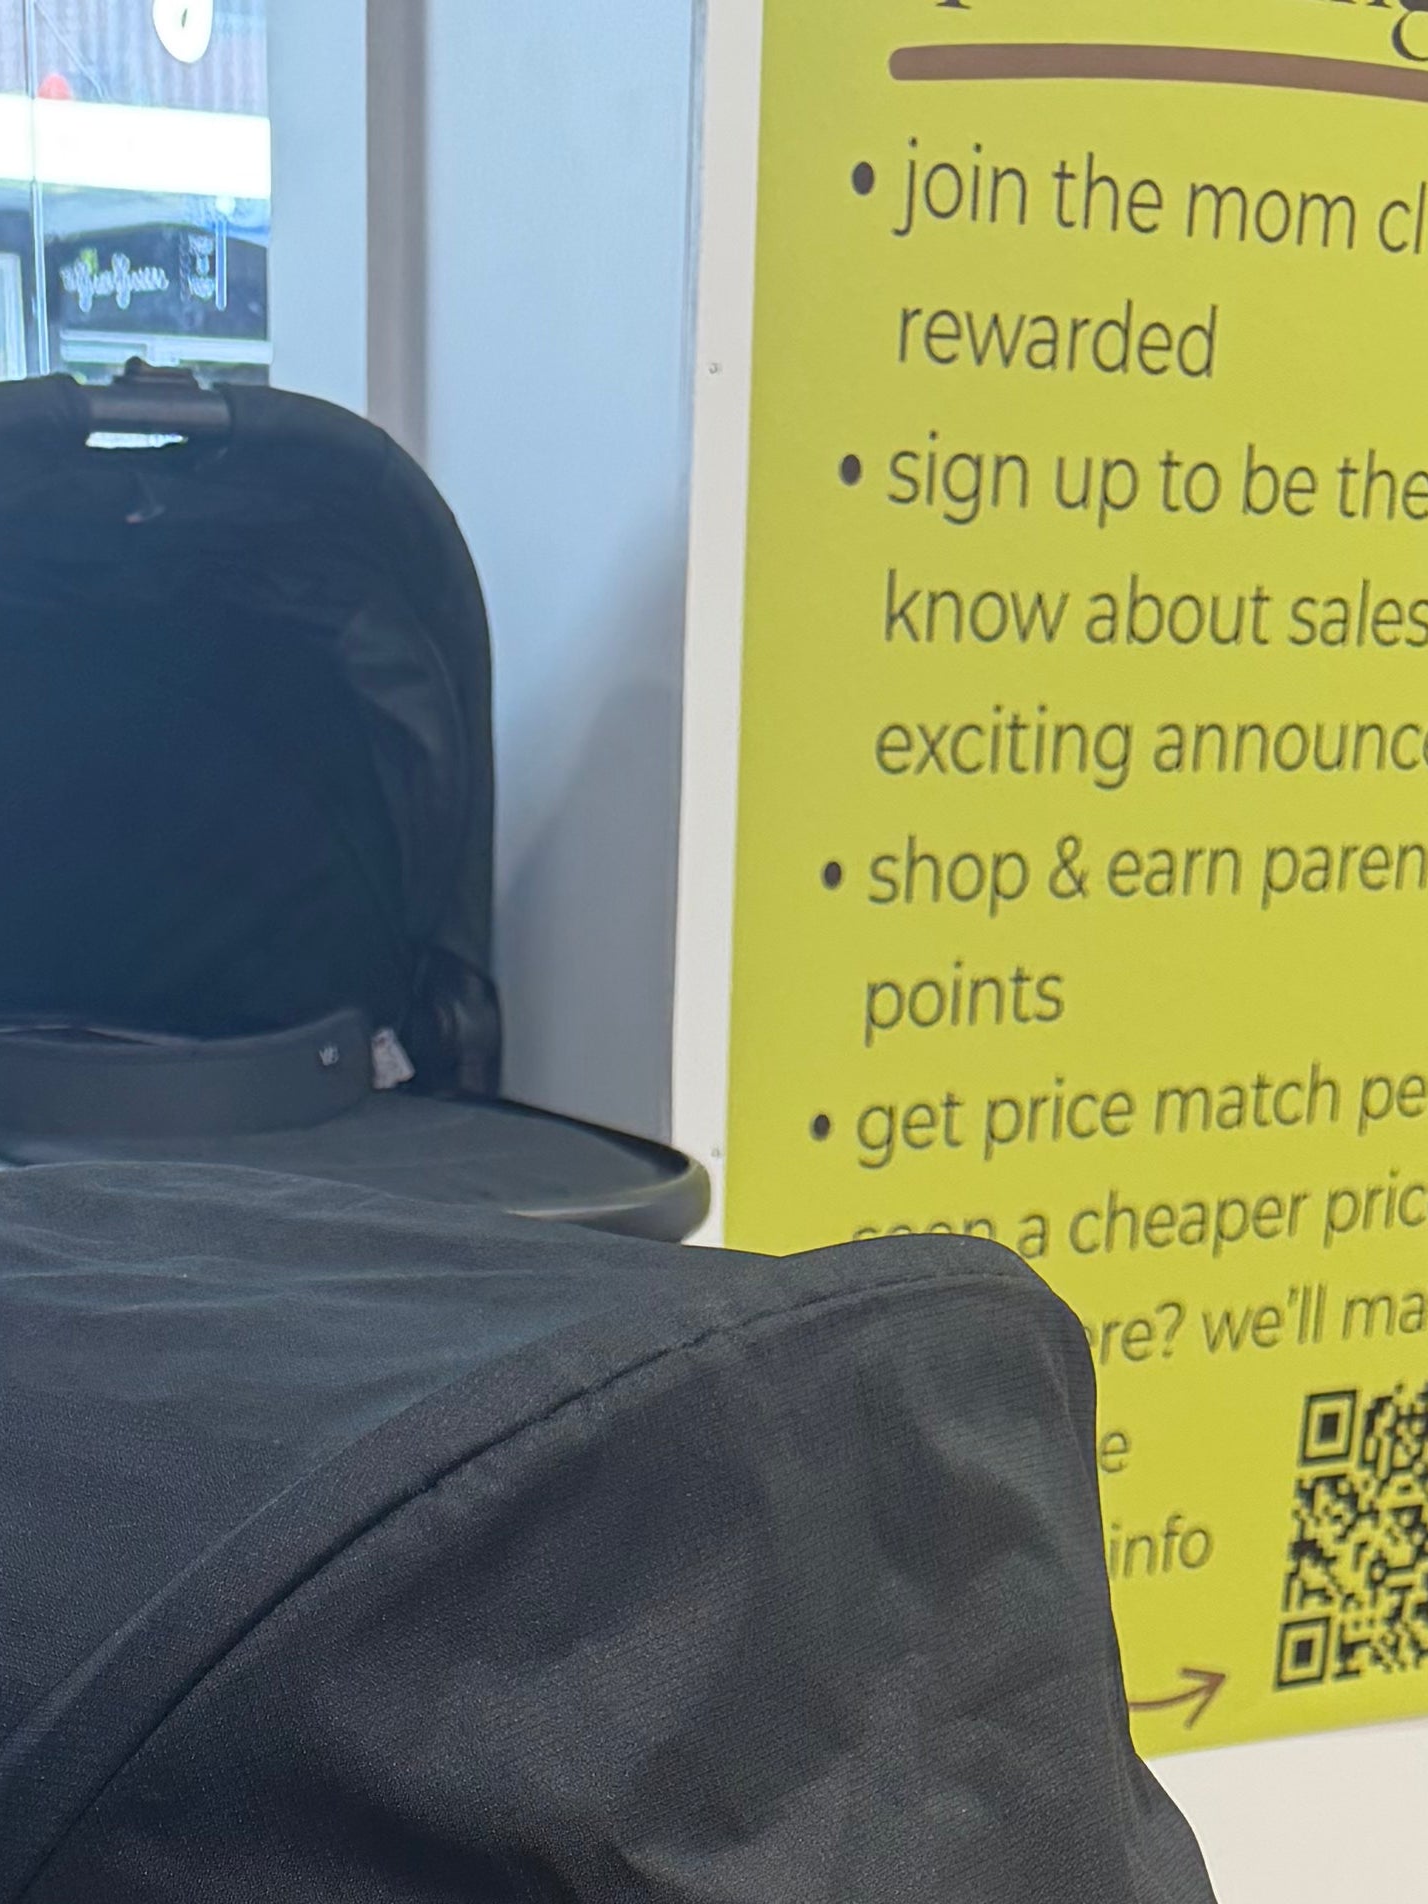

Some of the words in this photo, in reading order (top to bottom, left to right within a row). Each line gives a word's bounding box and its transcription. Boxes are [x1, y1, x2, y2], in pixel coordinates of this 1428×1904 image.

[891, 137, 1027, 237] join
[1052, 152, 1163, 234] the
[1187, 183, 1355, 249] mom
[898, 298, 1217, 378] rewarded
[887, 430, 1028, 526] sign
[1056, 456, 1139, 529] up
[1159, 449, 1221, 514] to
[1242, 443, 1318, 517] be
[885, 568, 1069, 643] know
[1085, 572, 1272, 645] about
[875, 704, 1132, 791] exciting
[868, 834, 1029, 918] shop
[1049, 834, 1088, 900] &
[1107, 847, 1241, 898] earn
[865, 960, 1064, 1048] points
[857, 1092, 960, 1170] get
[984, 1077, 1135, 1161] price
[1155, 1063, 1340, 1134] match
[1012, 1214, 1049, 1262] a
[1069, 1190, 1308, 1258] cheaper
[1202, 1284, 1326, 1353] we'll
[1109, 1515, 1213, 1578] info
